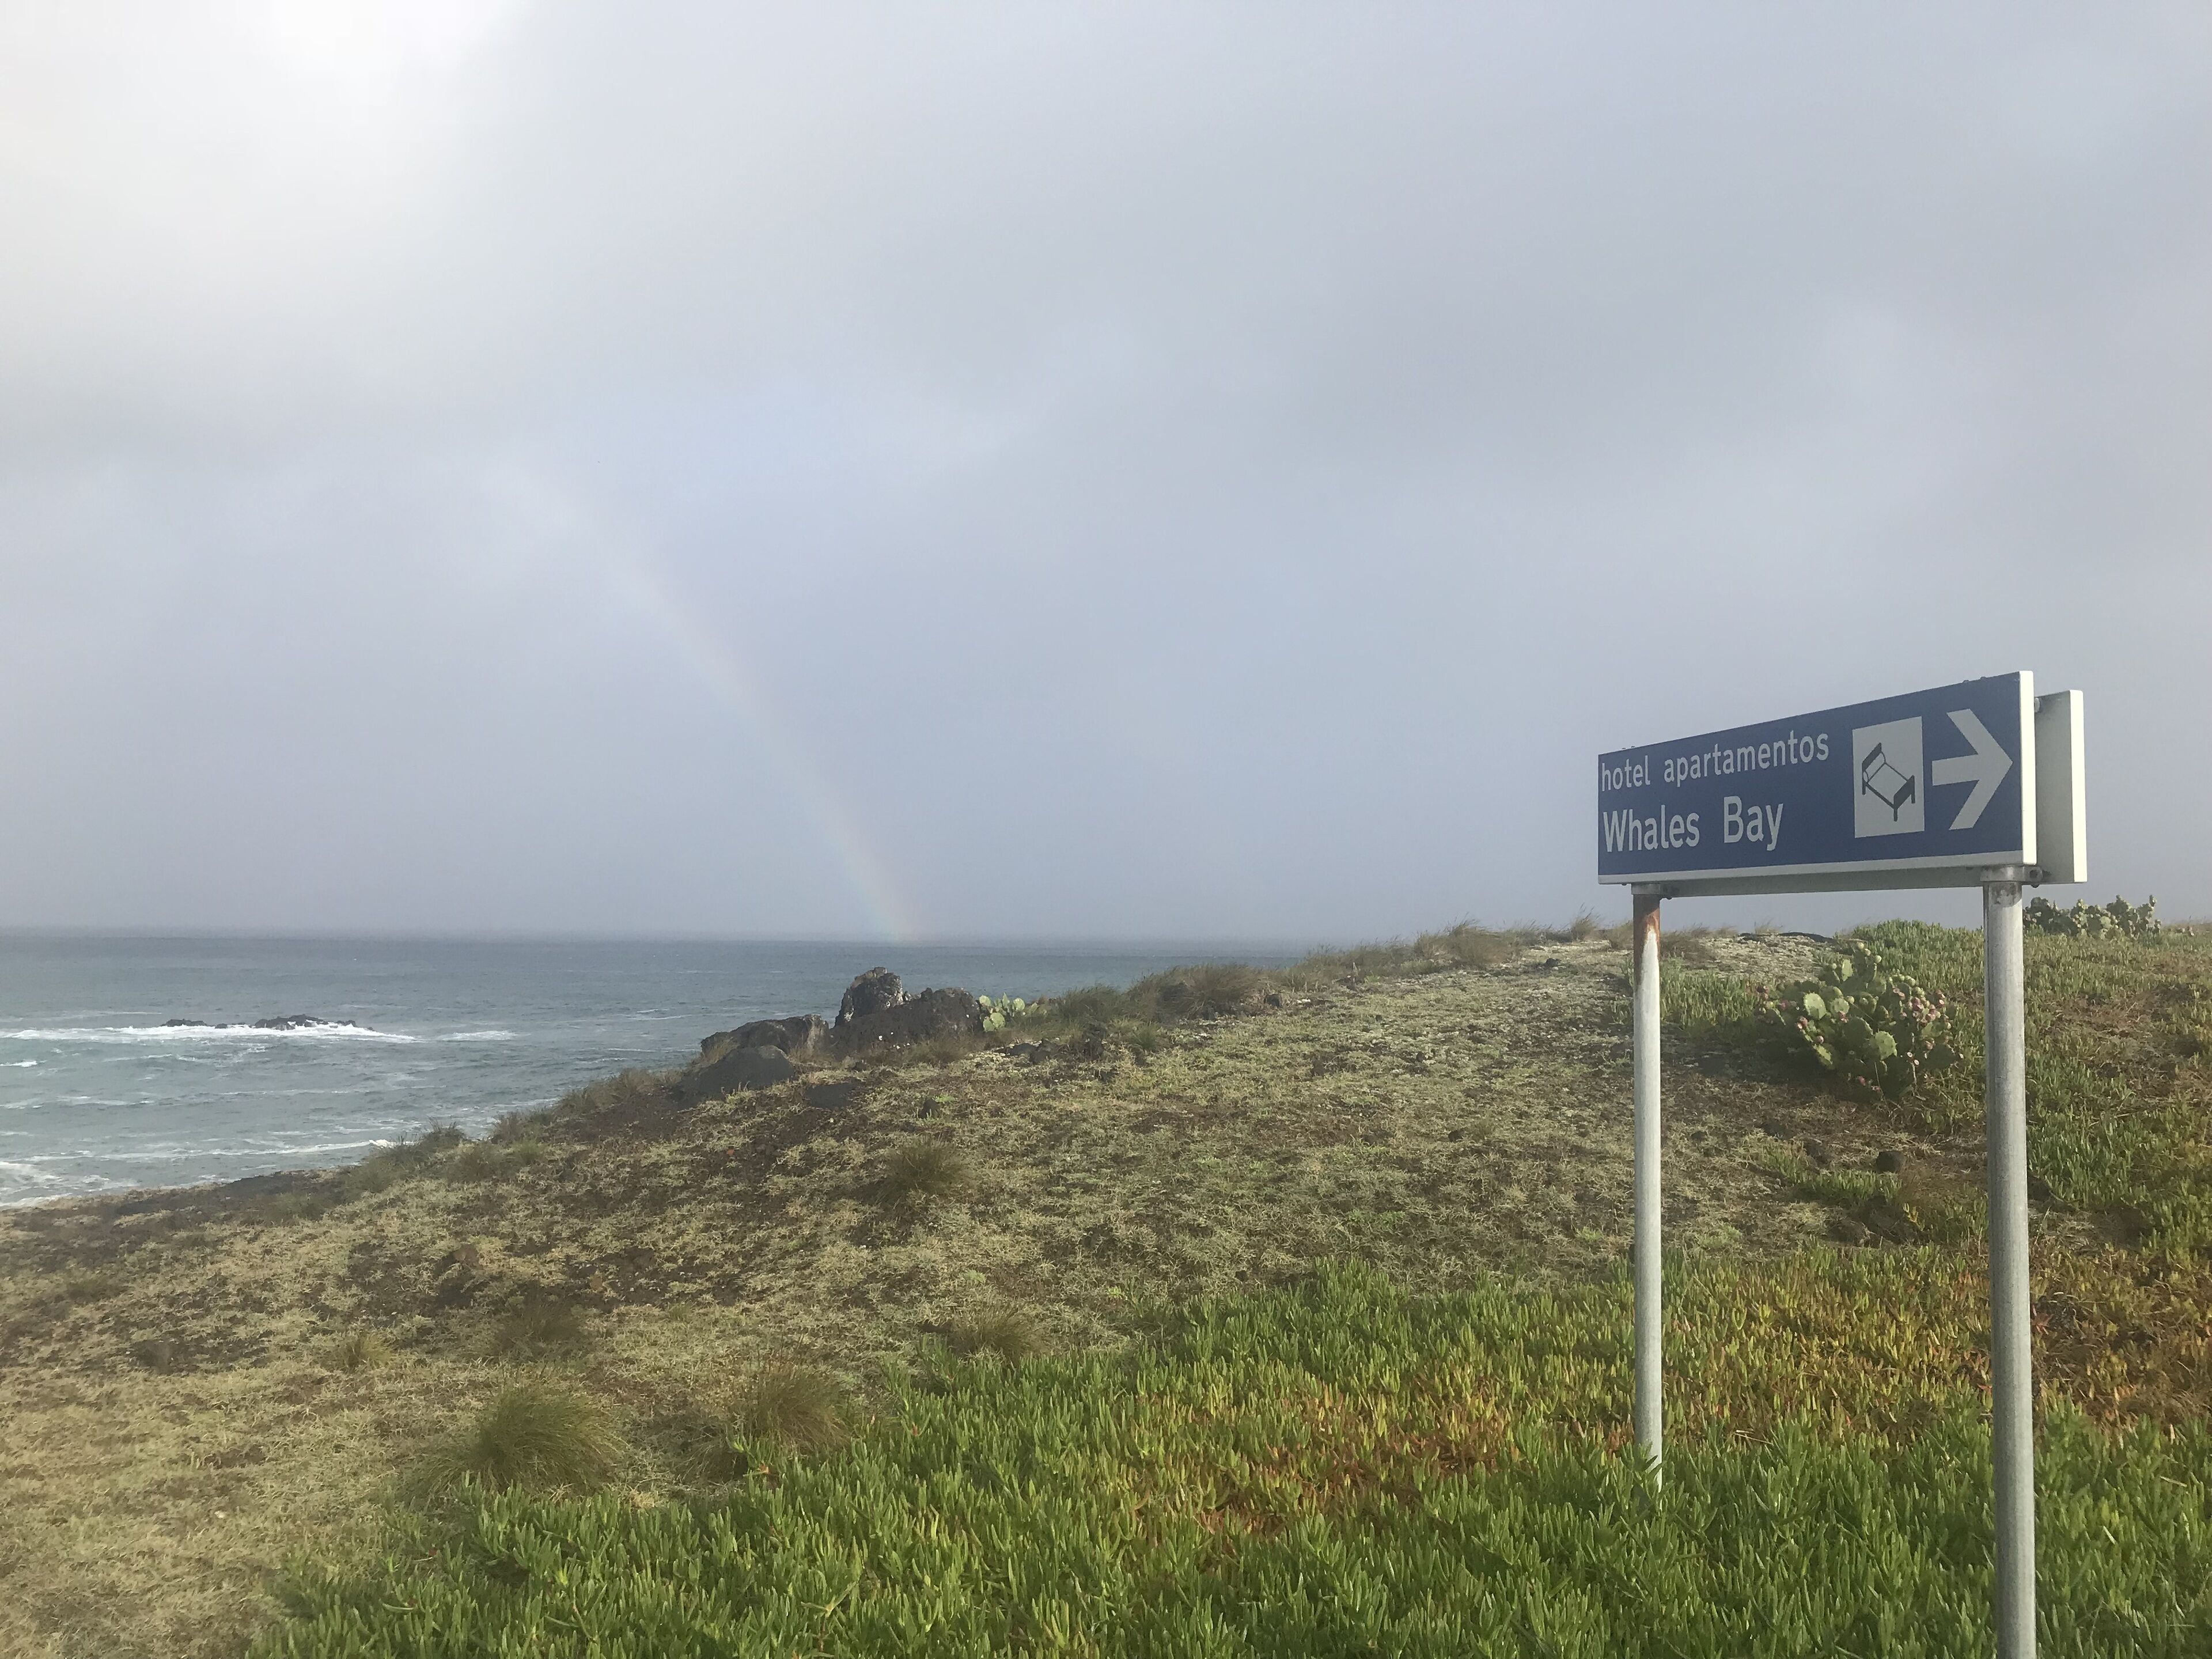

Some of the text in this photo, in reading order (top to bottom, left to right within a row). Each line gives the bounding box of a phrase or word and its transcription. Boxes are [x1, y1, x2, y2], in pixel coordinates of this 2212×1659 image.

[1601, 730, 1830, 791] hotel apartamentos
[1603, 796, 1784, 853] Whales Bay
